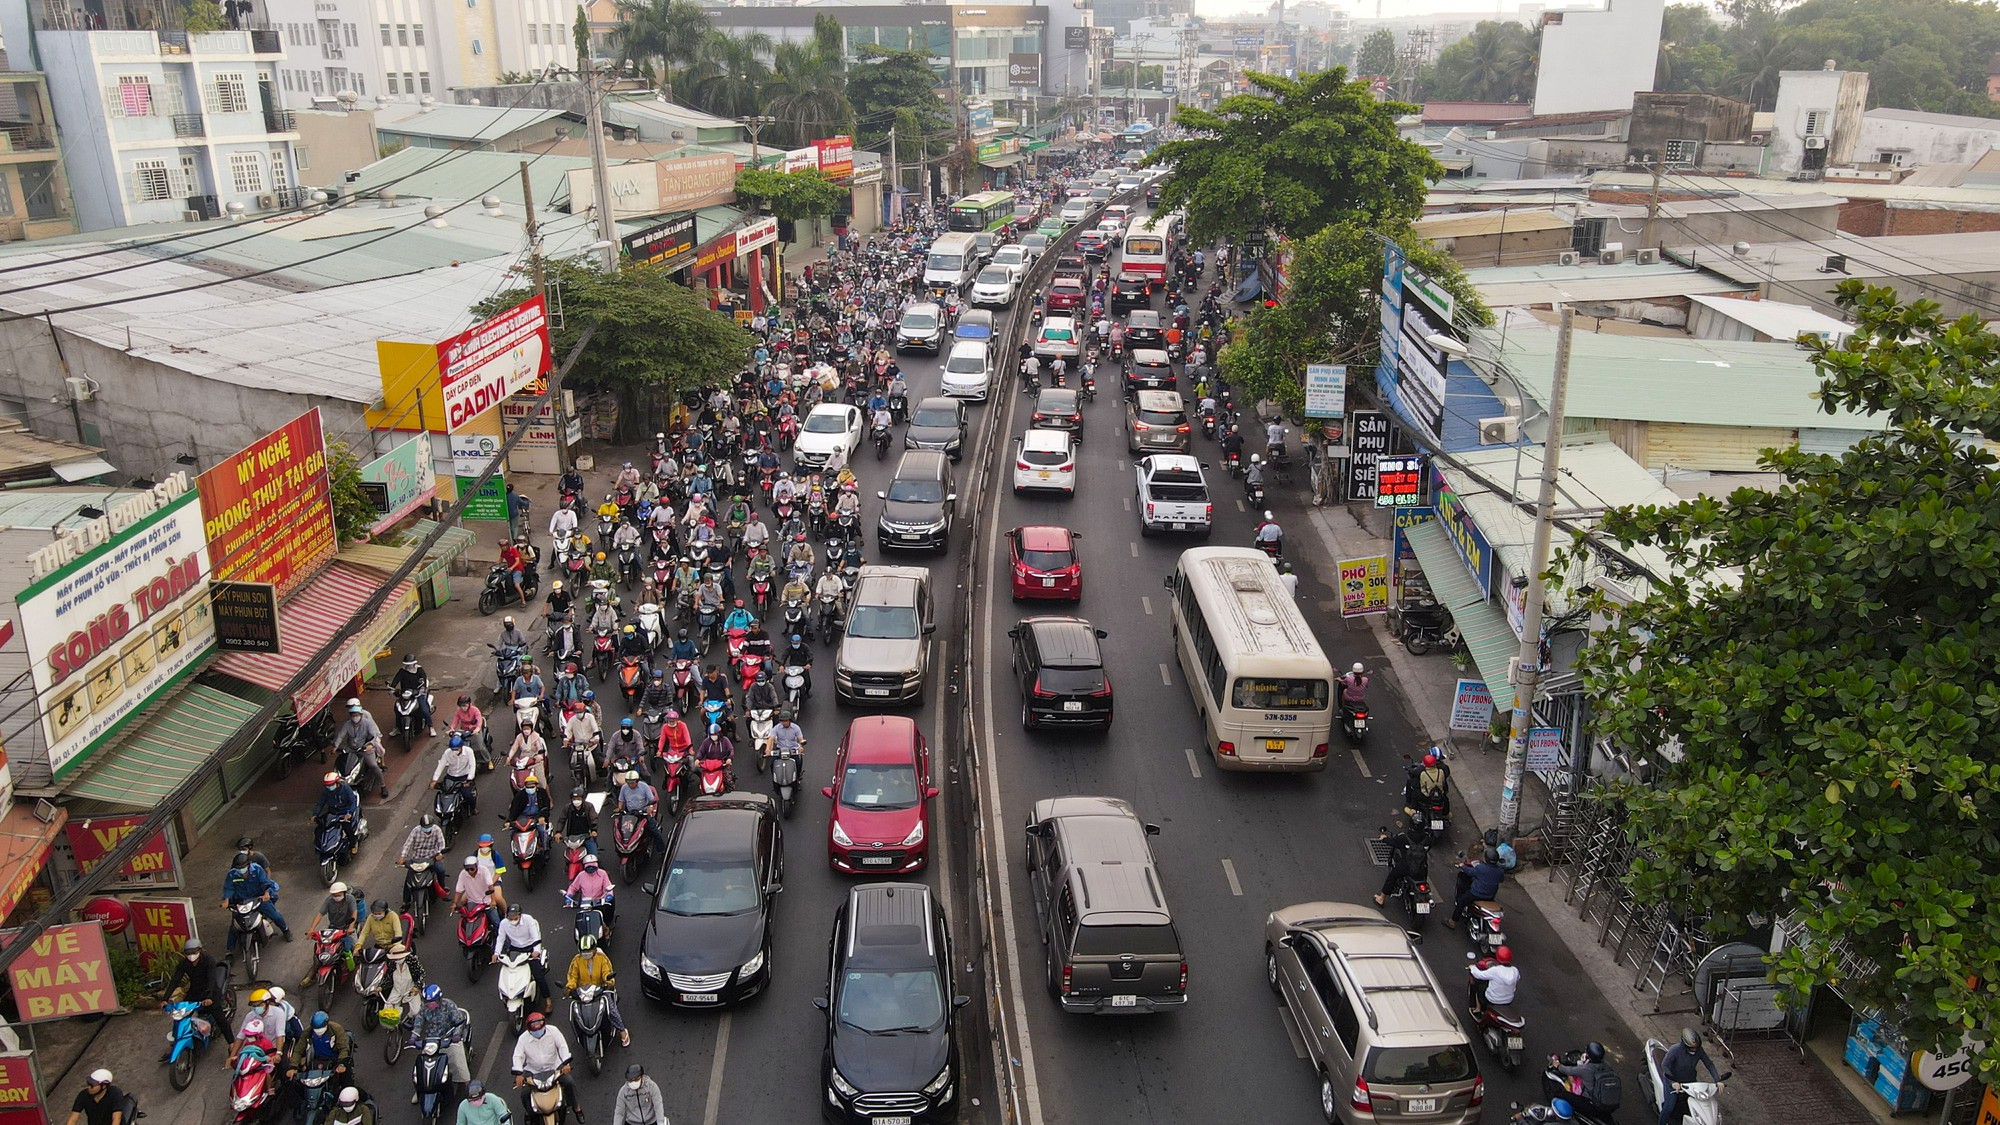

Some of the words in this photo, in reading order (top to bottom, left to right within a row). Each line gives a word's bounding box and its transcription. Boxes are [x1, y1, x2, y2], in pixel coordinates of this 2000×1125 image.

[445, 389, 456, 401] DÂY
[457, 381, 468, 394] CÁP
[469, 374, 481, 387] ĐIỆN
[450, 376, 506, 428] CADIVI
[503, 403, 524, 415] TIẾN
[1359, 416, 1386, 433] SẢN
[1358, 436, 1385, 452] PHỤ
[237, 451, 256, 485] MỸ
[258, 432, 290, 472] NGHỆ
[1354, 466, 1375, 481] SIÊ
[206, 497, 251, 541] PHONG
[252, 473, 283, 511] THỦY
[285, 462, 304, 490] TẠI
[306, 450, 324, 476] GIA
[108, 489, 156, 532] PHUN
[1396, 509, 1422, 527] CẮT
[57, 583, 73, 600] MÁY
[75, 570, 94, 591] PHUN
[95, 560, 110, 577] SƠN
[114, 549, 129, 564] MÁY
[130, 538, 147, 555] PHUN
[148, 529, 161, 544] BỘT
[162, 518, 177, 534] TRÉT
[56, 602, 72, 618] MÁY
[73, 588, 93, 607] PHUN
[151, 542, 168, 560] PHUN
[169, 531, 182, 546] SƠN
[1342, 564, 1366, 580] PHỞ
[1368, 577, 1387, 587] 30K
[232, 590, 251, 602] PHUN
[47, 604, 129, 686] SONG
[131, 552, 201, 623] TOÀN
[235, 605, 253, 617] PHUN
[131, 852, 164, 872] BAY
[145, 904, 173, 927] VÉ
[31, 927, 80, 957] VÉ
[139, 931, 187, 952] MÁY
[15, 959, 101, 989] MÁY
[28, 989, 103, 1017] BAY
